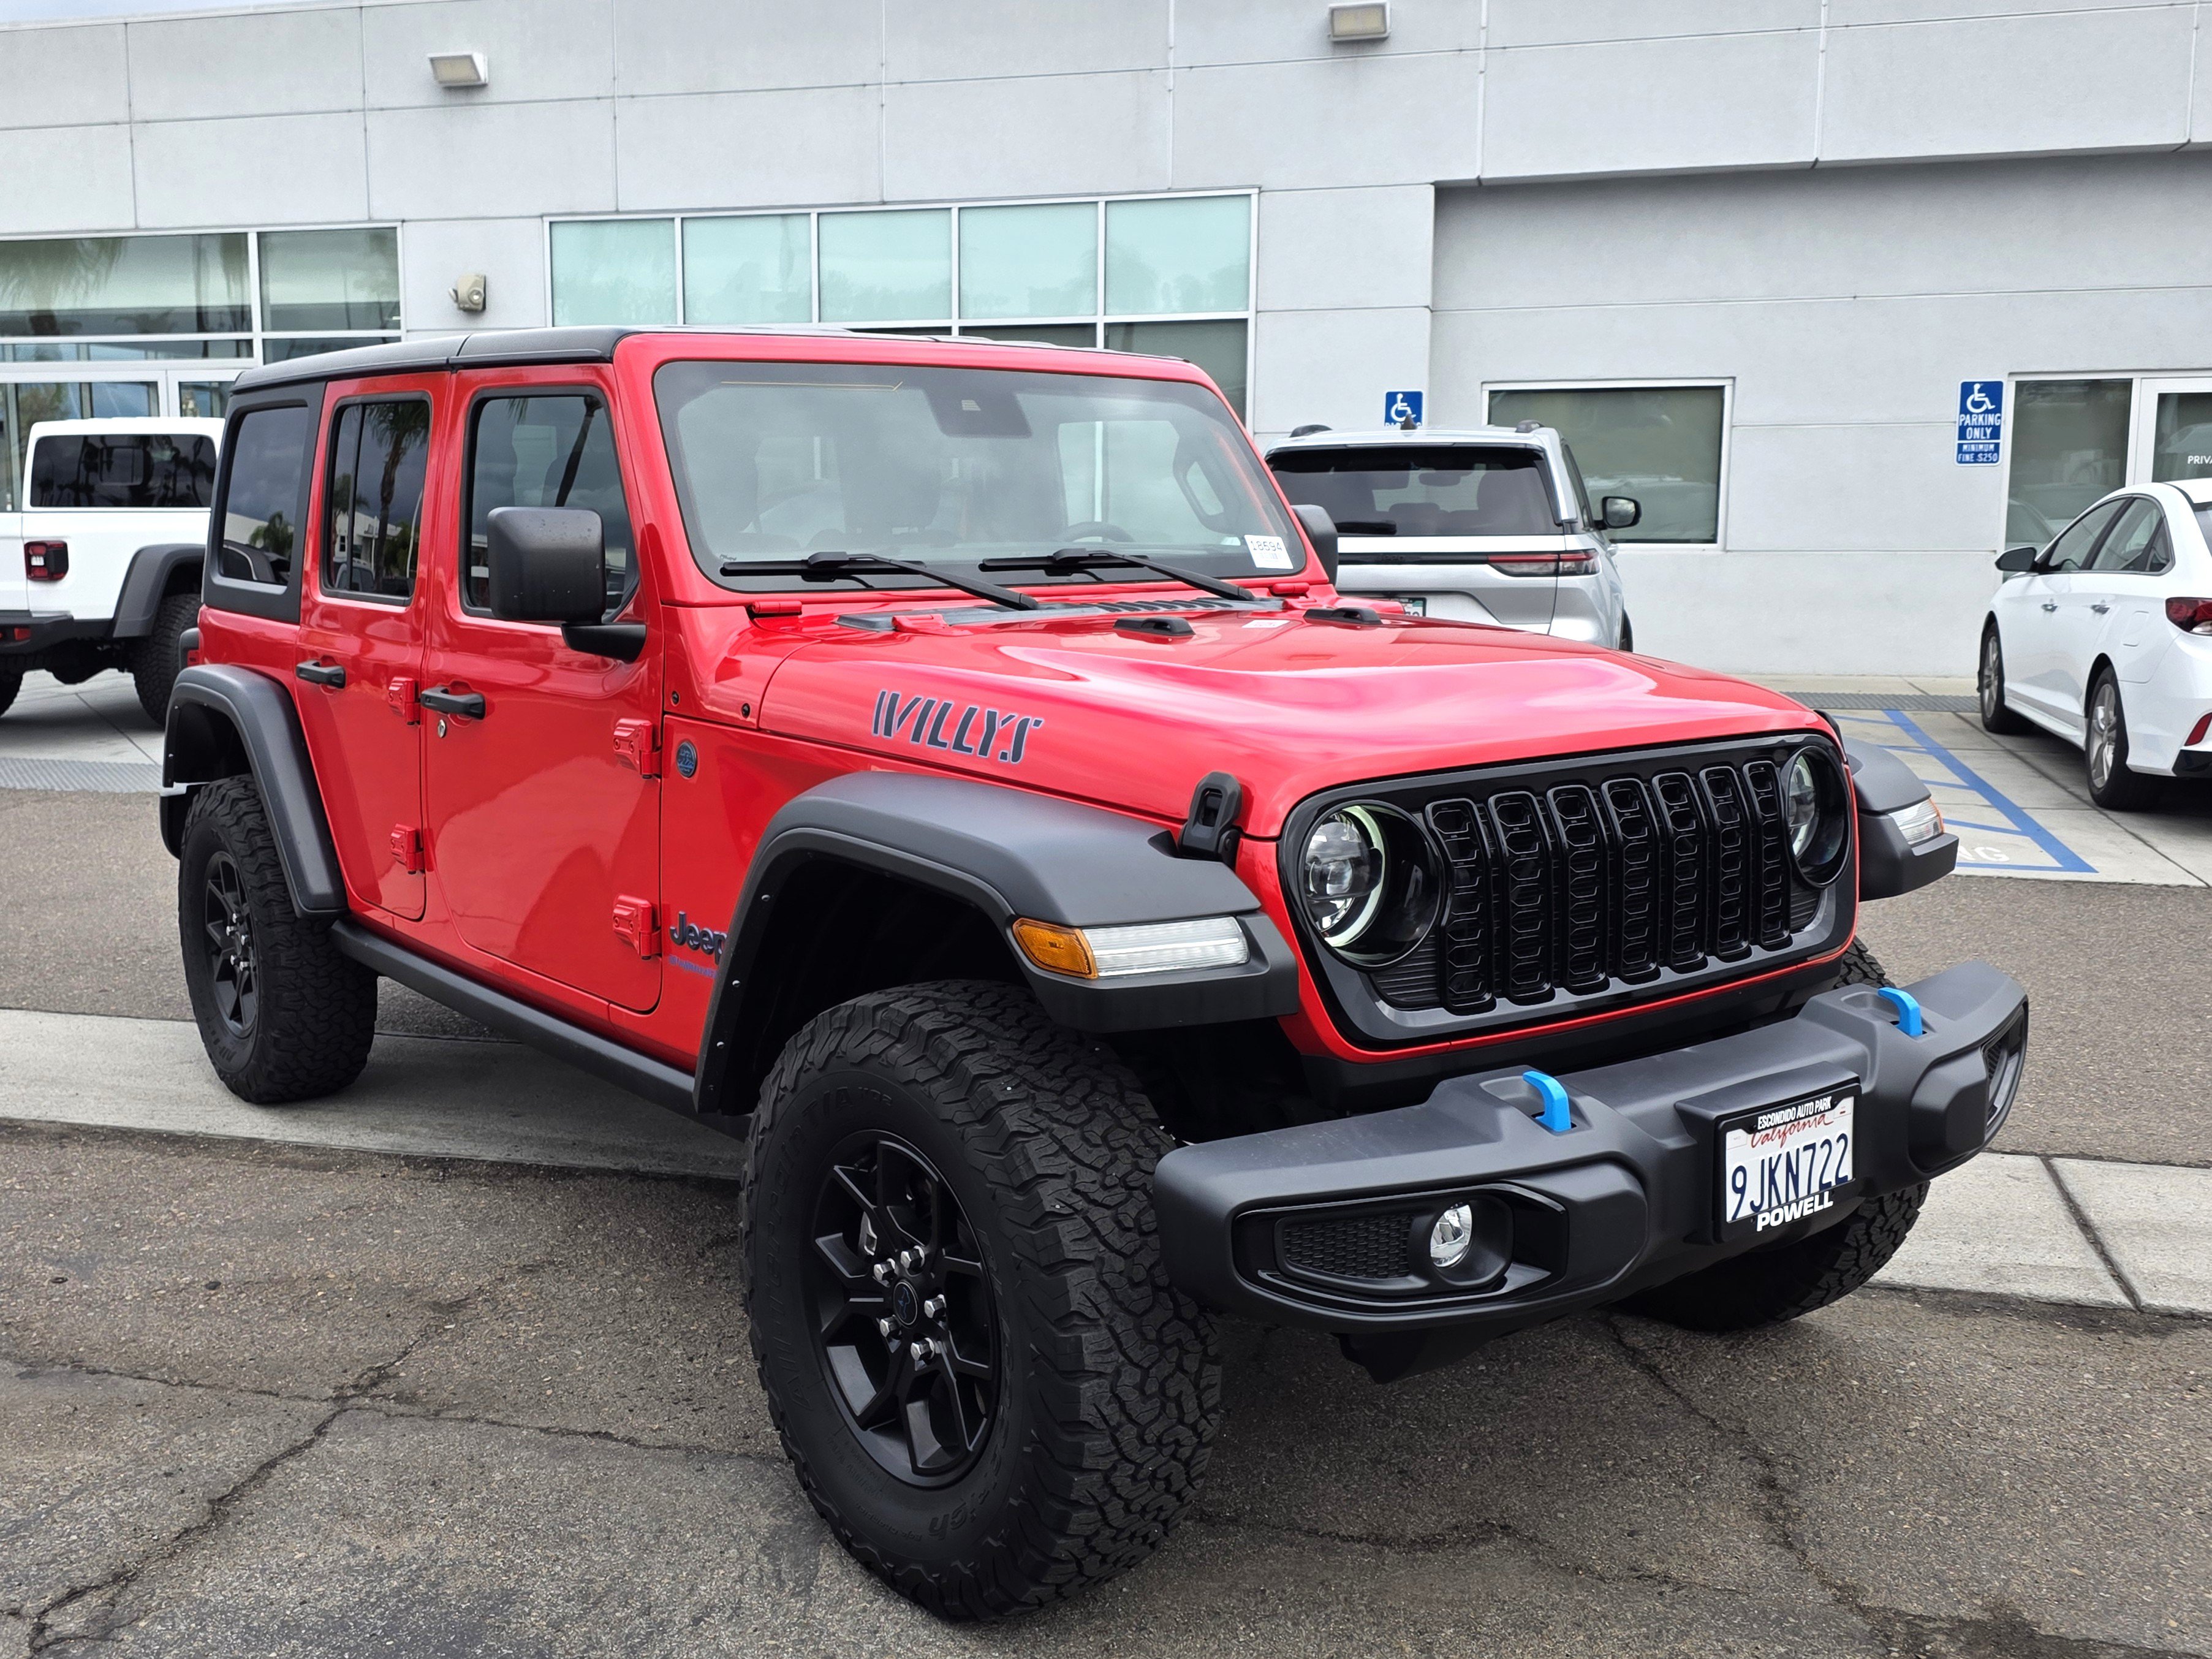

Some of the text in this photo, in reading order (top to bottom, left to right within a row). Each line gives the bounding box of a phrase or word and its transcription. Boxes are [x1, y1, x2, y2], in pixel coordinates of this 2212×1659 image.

[1959, 413, 2001, 426] PARKING
[1966, 427, 1993, 439] ONLY
[1957, 452, 1998, 462] FINE $250
[1962, 444, 1995, 452] MINIMUM
[1251, 541, 1282, 551] 18594
[873, 690, 1042, 764] WILLYS
[1757, 1107, 1797, 1130] ESCONDIDO
[1797, 1101, 1814, 1119] AUTO
[1814, 1096, 1832, 1114] PARK
[1751, 1114, 1834, 1148] California
[1731, 1133, 1849, 1221] 9JKN722
[1756, 1191, 1834, 1232] POWELL
